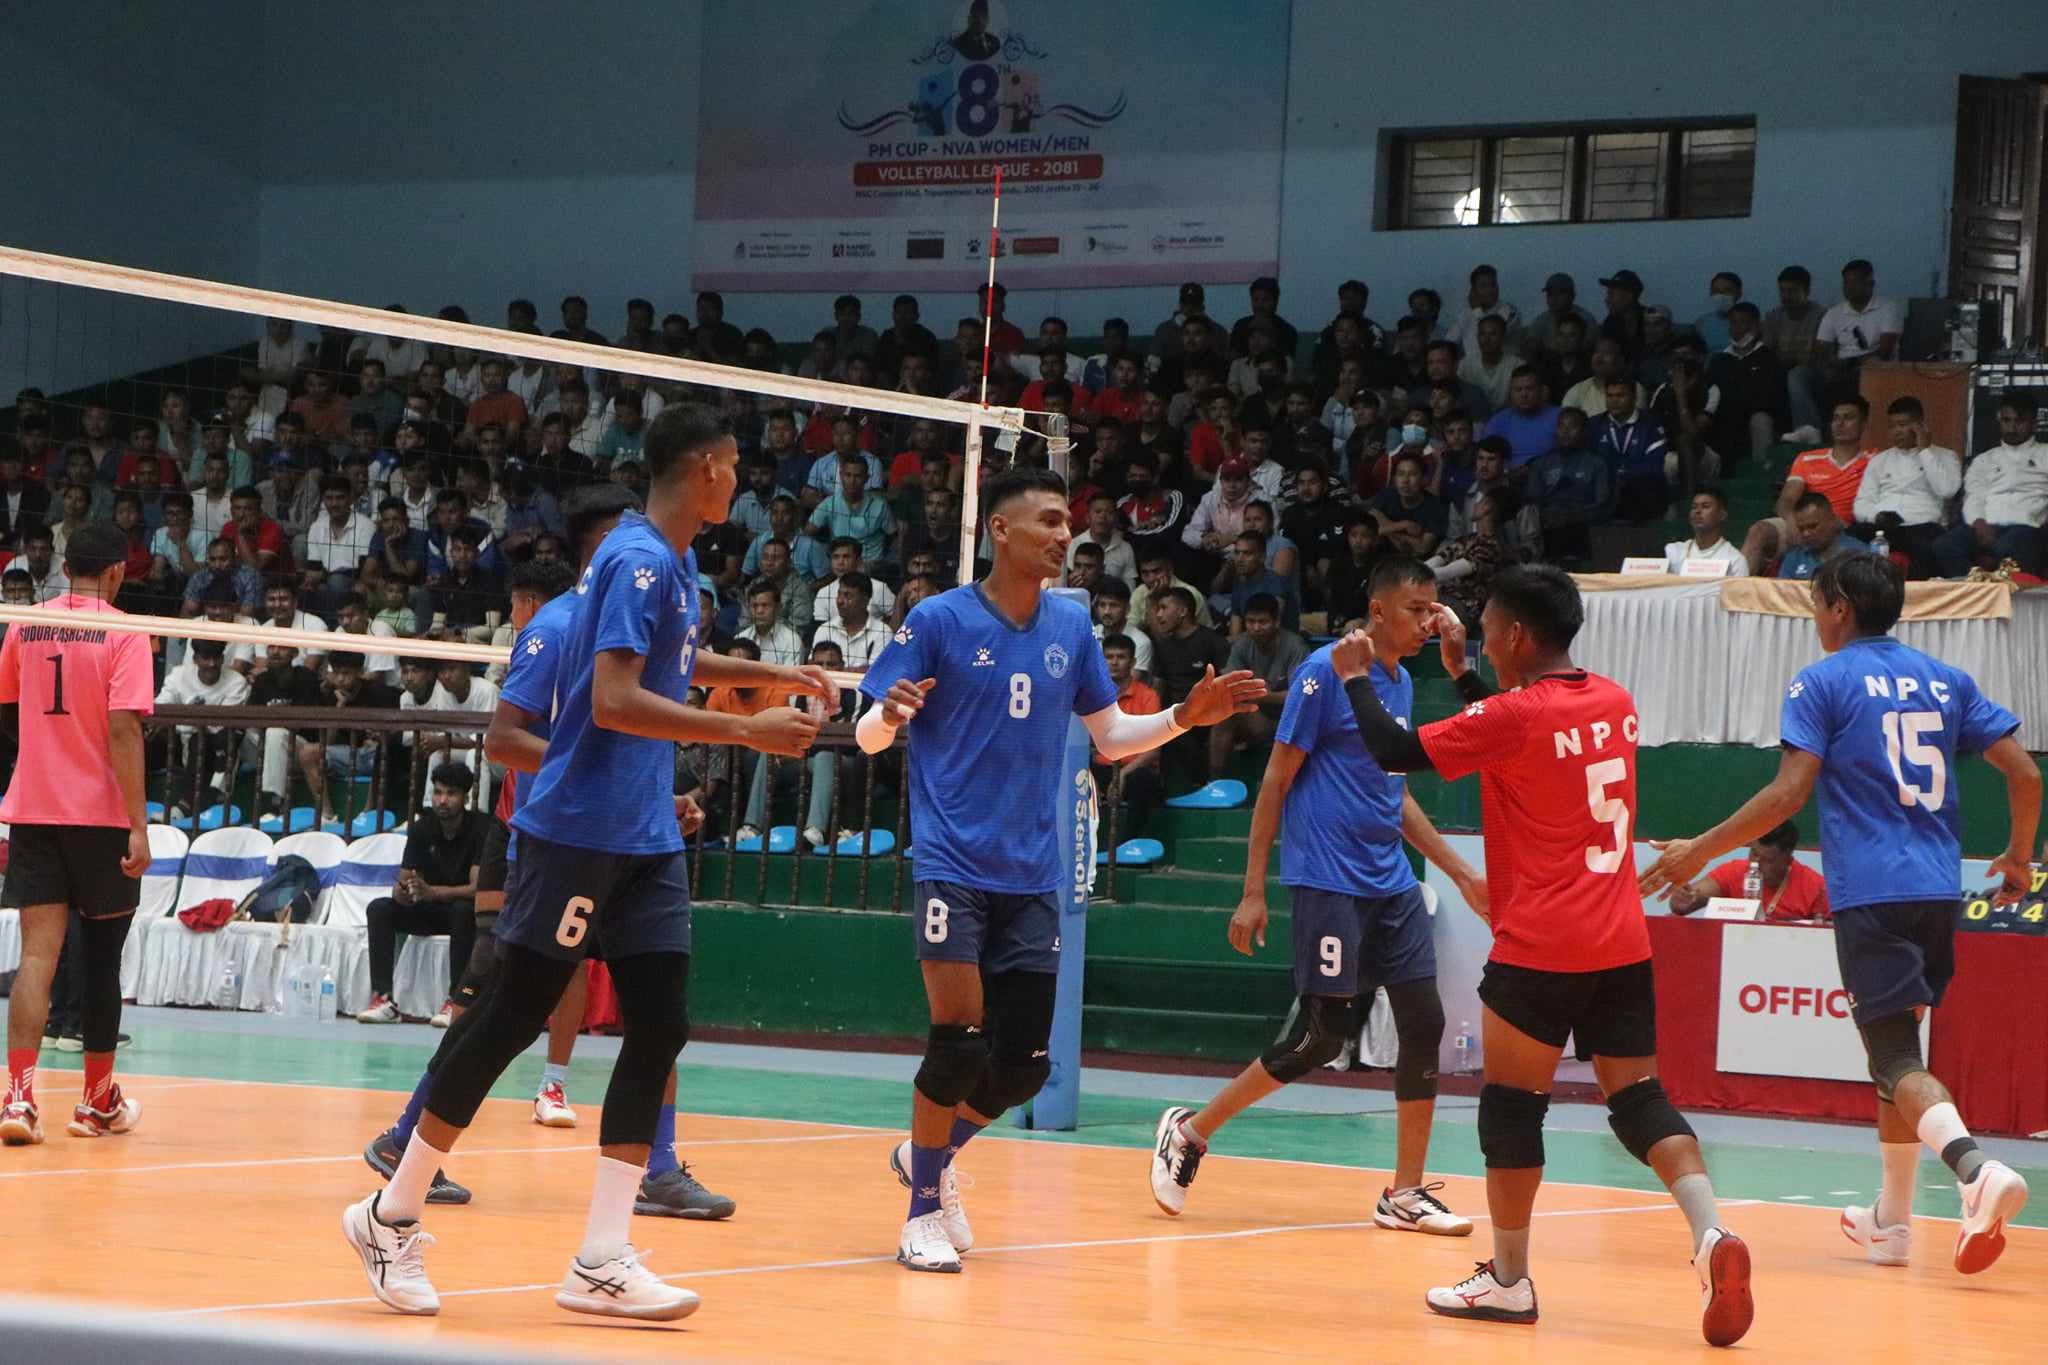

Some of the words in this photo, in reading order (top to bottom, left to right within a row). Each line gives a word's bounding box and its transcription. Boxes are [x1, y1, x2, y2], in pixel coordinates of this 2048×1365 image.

[869, 143, 893, 158] PM
[896, 142, 929, 157] CUP
[943, 140, 974, 155] NVA
[979, 135, 1089, 154] WOMEN/MEN
[879, 163, 972, 181] VOLLEYBALL
[1043, 160, 1079, 176] 2081
[680, 624, 697, 676] 6
[43, 653, 71, 716] 1
[1008, 672, 1031, 719] 8
[1882, 711, 1946, 812] 15
[1585, 757, 1630, 874] 5
[555, 895, 594, 948] 6
[925, 898, 949, 944] 8
[2022, 903, 2045, 922] 4
[1319, 935, 1343, 977] 9
